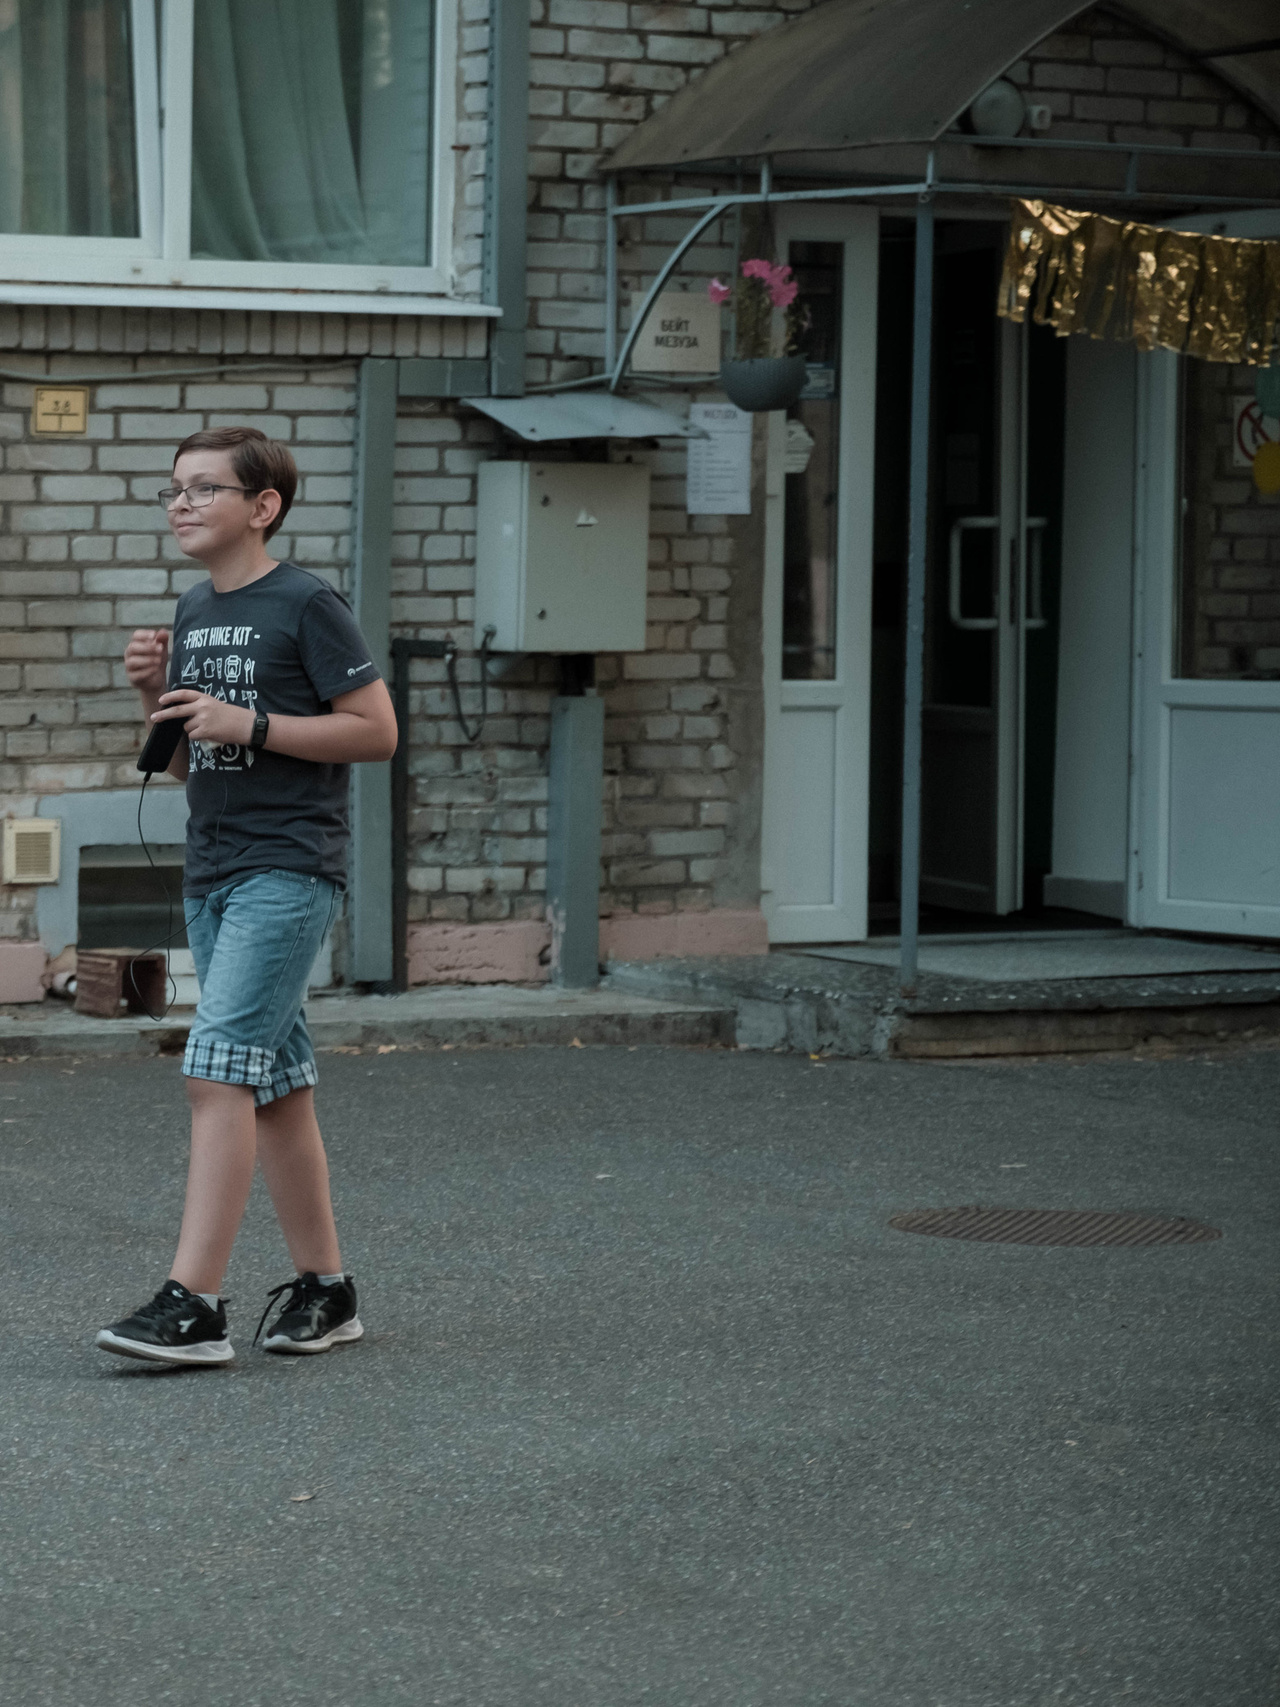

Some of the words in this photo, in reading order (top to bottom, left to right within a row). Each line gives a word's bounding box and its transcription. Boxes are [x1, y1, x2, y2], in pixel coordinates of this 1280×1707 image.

[661, 316, 690, 332] БЕЙТ
[654, 335, 699, 349] МЕЗУЗА
[209, 626, 232, 646] HIKE
[232, 626, 253, 646] KIT
